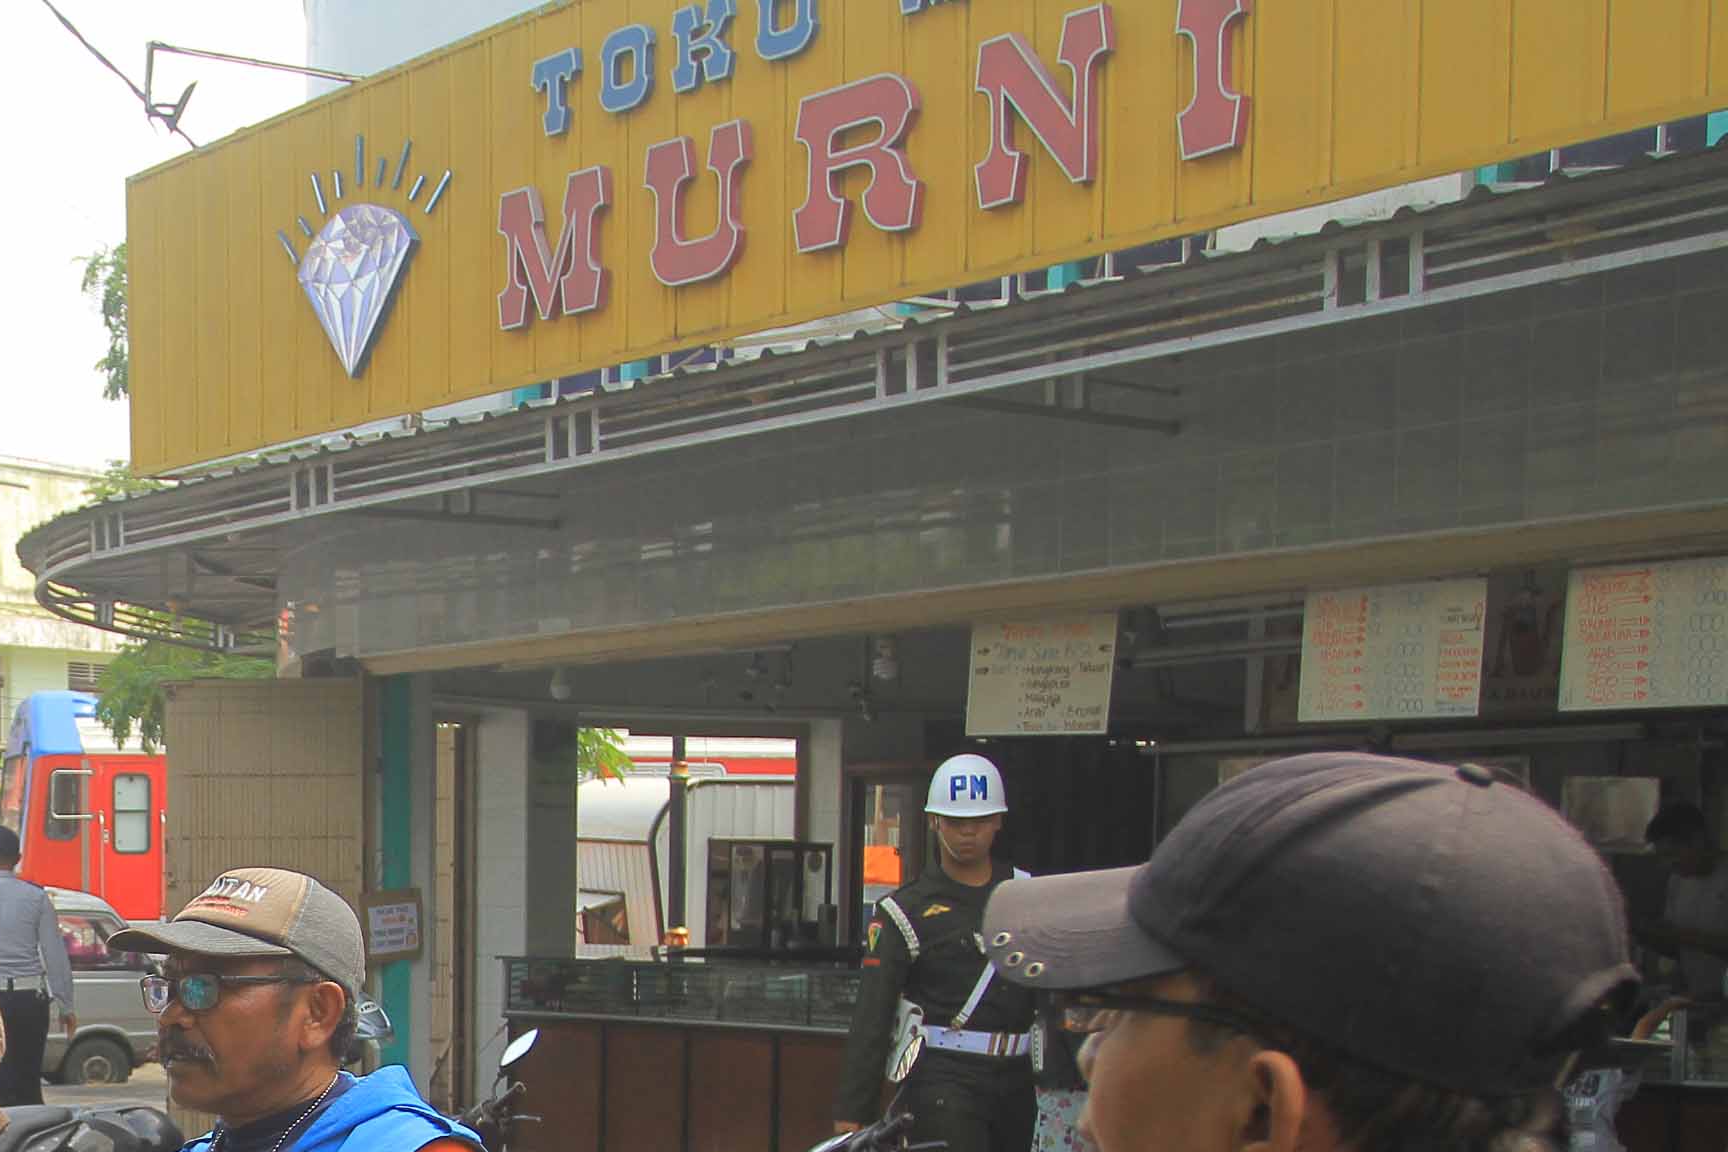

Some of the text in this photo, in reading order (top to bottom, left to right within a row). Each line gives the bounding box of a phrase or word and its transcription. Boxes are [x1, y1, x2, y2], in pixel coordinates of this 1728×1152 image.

[530, 0, 818, 137] TOKO
[497, 0, 1250, 331] MURNI
[950, 775, 988, 801] PM
